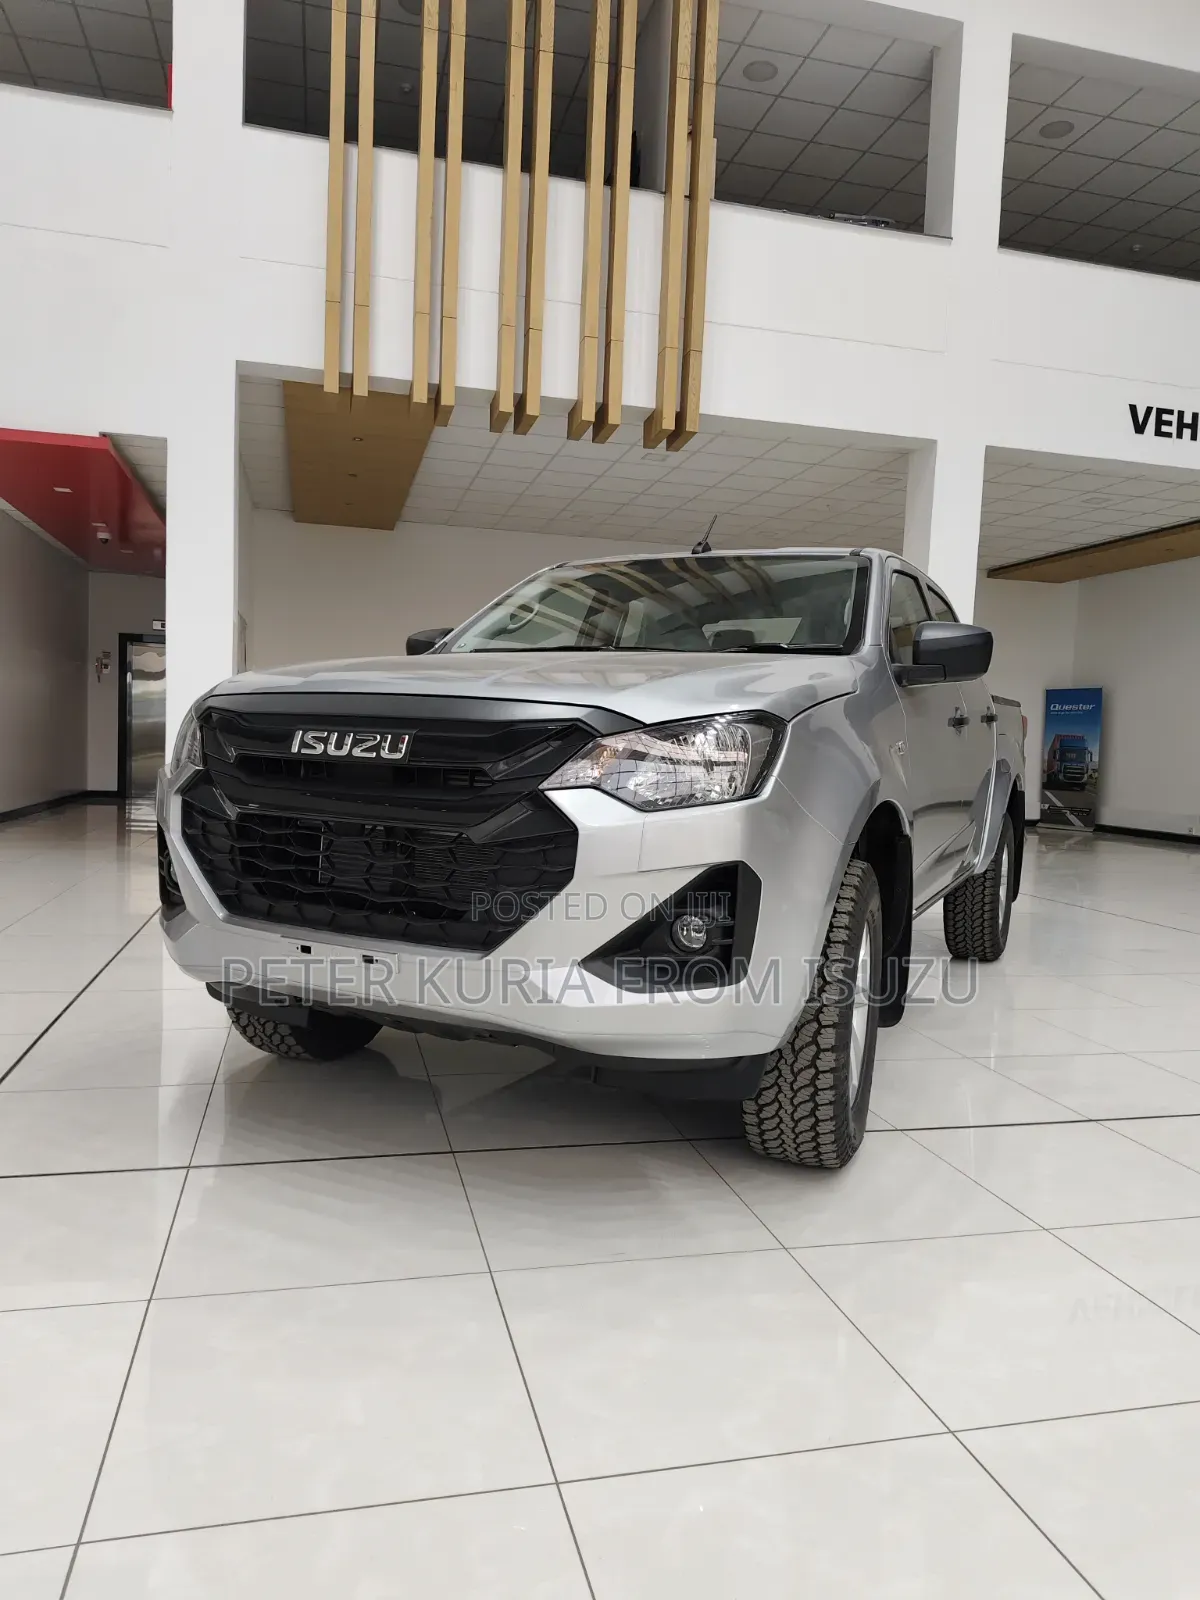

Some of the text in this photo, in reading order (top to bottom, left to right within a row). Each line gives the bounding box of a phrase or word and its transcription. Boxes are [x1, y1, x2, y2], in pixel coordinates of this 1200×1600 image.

[1128, 403, 1199, 442] VEH
[1050, 703, 1096, 711] Quester
[291, 729, 409, 759] ISUZU
